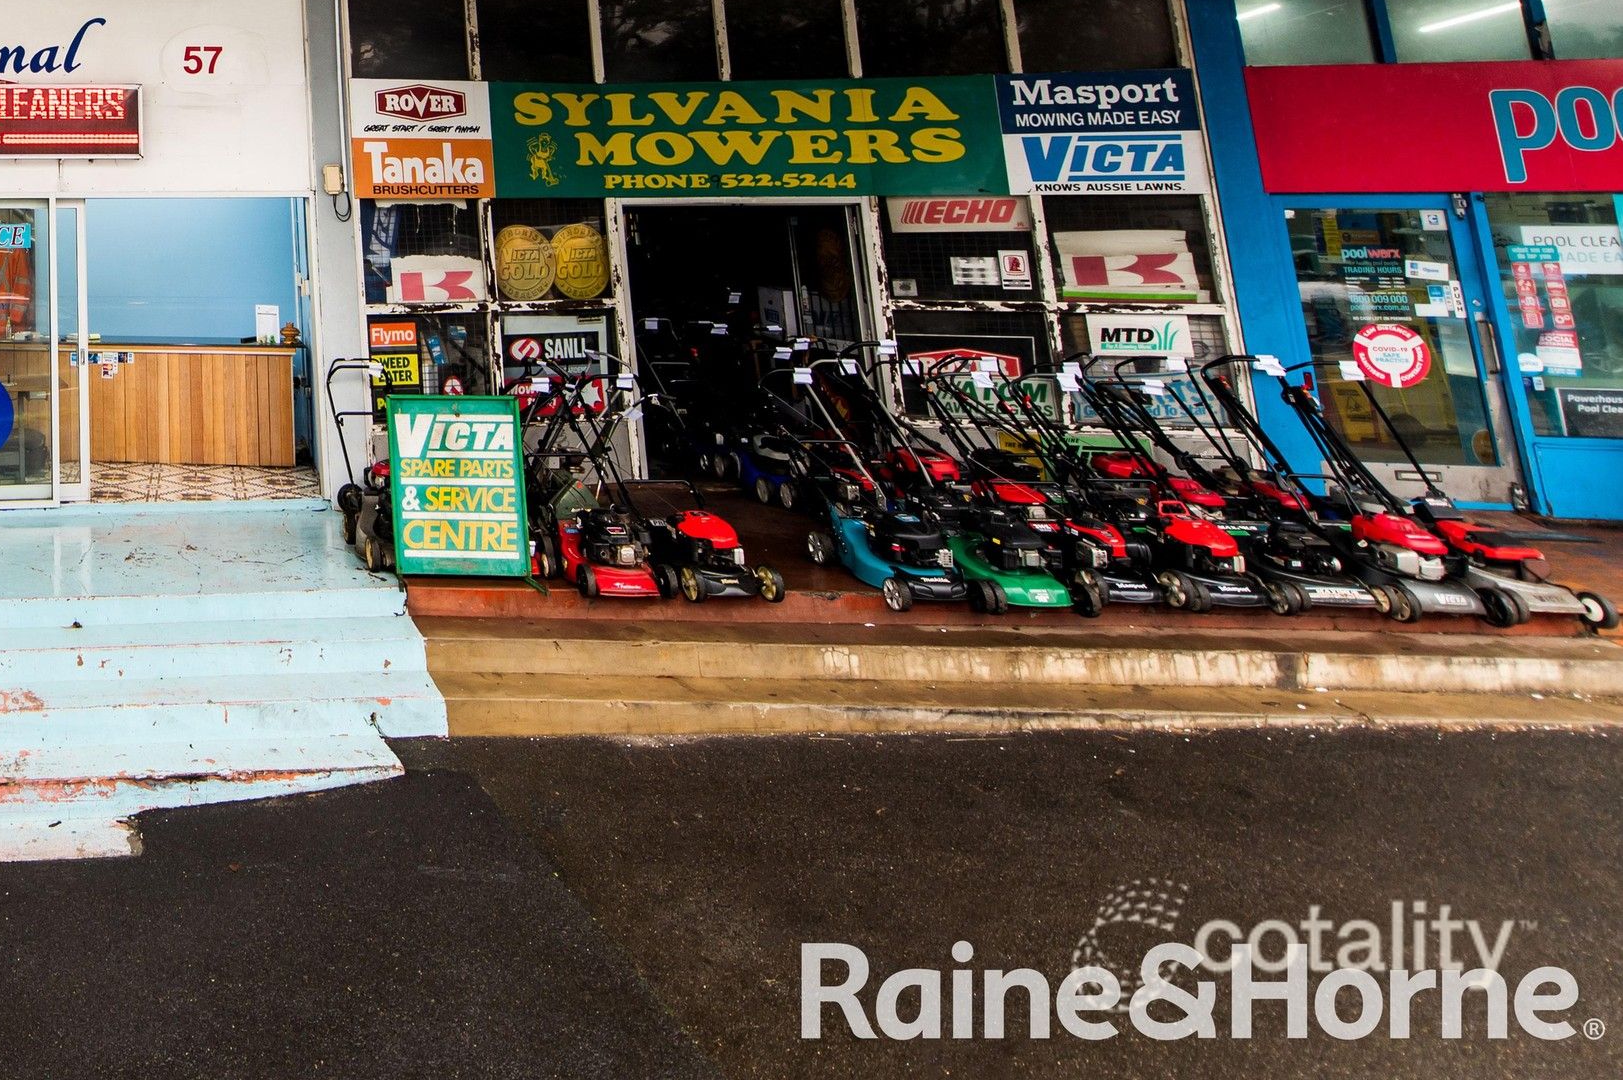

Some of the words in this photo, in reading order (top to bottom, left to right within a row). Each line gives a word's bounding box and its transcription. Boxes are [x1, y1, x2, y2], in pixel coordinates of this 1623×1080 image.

[183, 46, 224, 75] 57
[1010, 77, 1179, 109] Masport
[384, 89, 457, 118] ROVER
[513, 86, 961, 126] SYLVANIA
[1015, 112, 1085, 127] MOWING
[1088, 111, 1136, 126] MADE
[1139, 110, 1180, 124] EASY
[363, 124, 391, 132] GREAT
[392, 124, 418, 133] START
[427, 125, 454, 133] GREAT
[454, 125, 481, 133] FINISH
[1489, 85, 1623, 184] po
[574, 127, 967, 167] MOWERS
[363, 141, 485, 184] Tanaka
[1021, 135, 1186, 182] VICTA
[372, 185, 480, 195] BRUSHCUTTERS
[603, 174, 711, 190] PHONE
[720, 173, 857, 189] 522.5244
[1035, 183, 1081, 192] KNOWS
[1086, 183, 1132, 191] AUSSIE
[1136, 182, 1186, 191] LAWNS.
[924, 199, 1018, 224] ECHO
[1533, 236, 1576, 247] POOL
[502, 247, 541, 263] VICTA
[561, 247, 597, 263] VICTA
[498, 263, 550, 281] GOLD
[557, 263, 605, 280] GOLD
[1343, 266, 1375, 274] TRADING
[1377, 266, 1403, 274] HOURS
[1371, 295, 1389, 303] 009
[1390, 295, 1408, 303] 000
[1453, 286, 1463, 312] PUSH
[371, 328, 415, 344] Flymo
[1100, 328, 1155, 343] MTD
[1376, 325, 1412, 339] DISTANCE
[544, 337, 586, 359] SANLI
[379, 357, 410, 369] WEED
[1578, 405, 1599, 413] Pool
[394, 414, 514, 459] VICTA
[400, 459, 455, 477] SPARE
[459, 459, 514, 478] PARTS
[401, 486, 420, 511] &
[425, 487, 516, 512] SERVICE
[403, 521, 518, 551] CENTRE
[1434, 592, 1466, 605] VICTA
